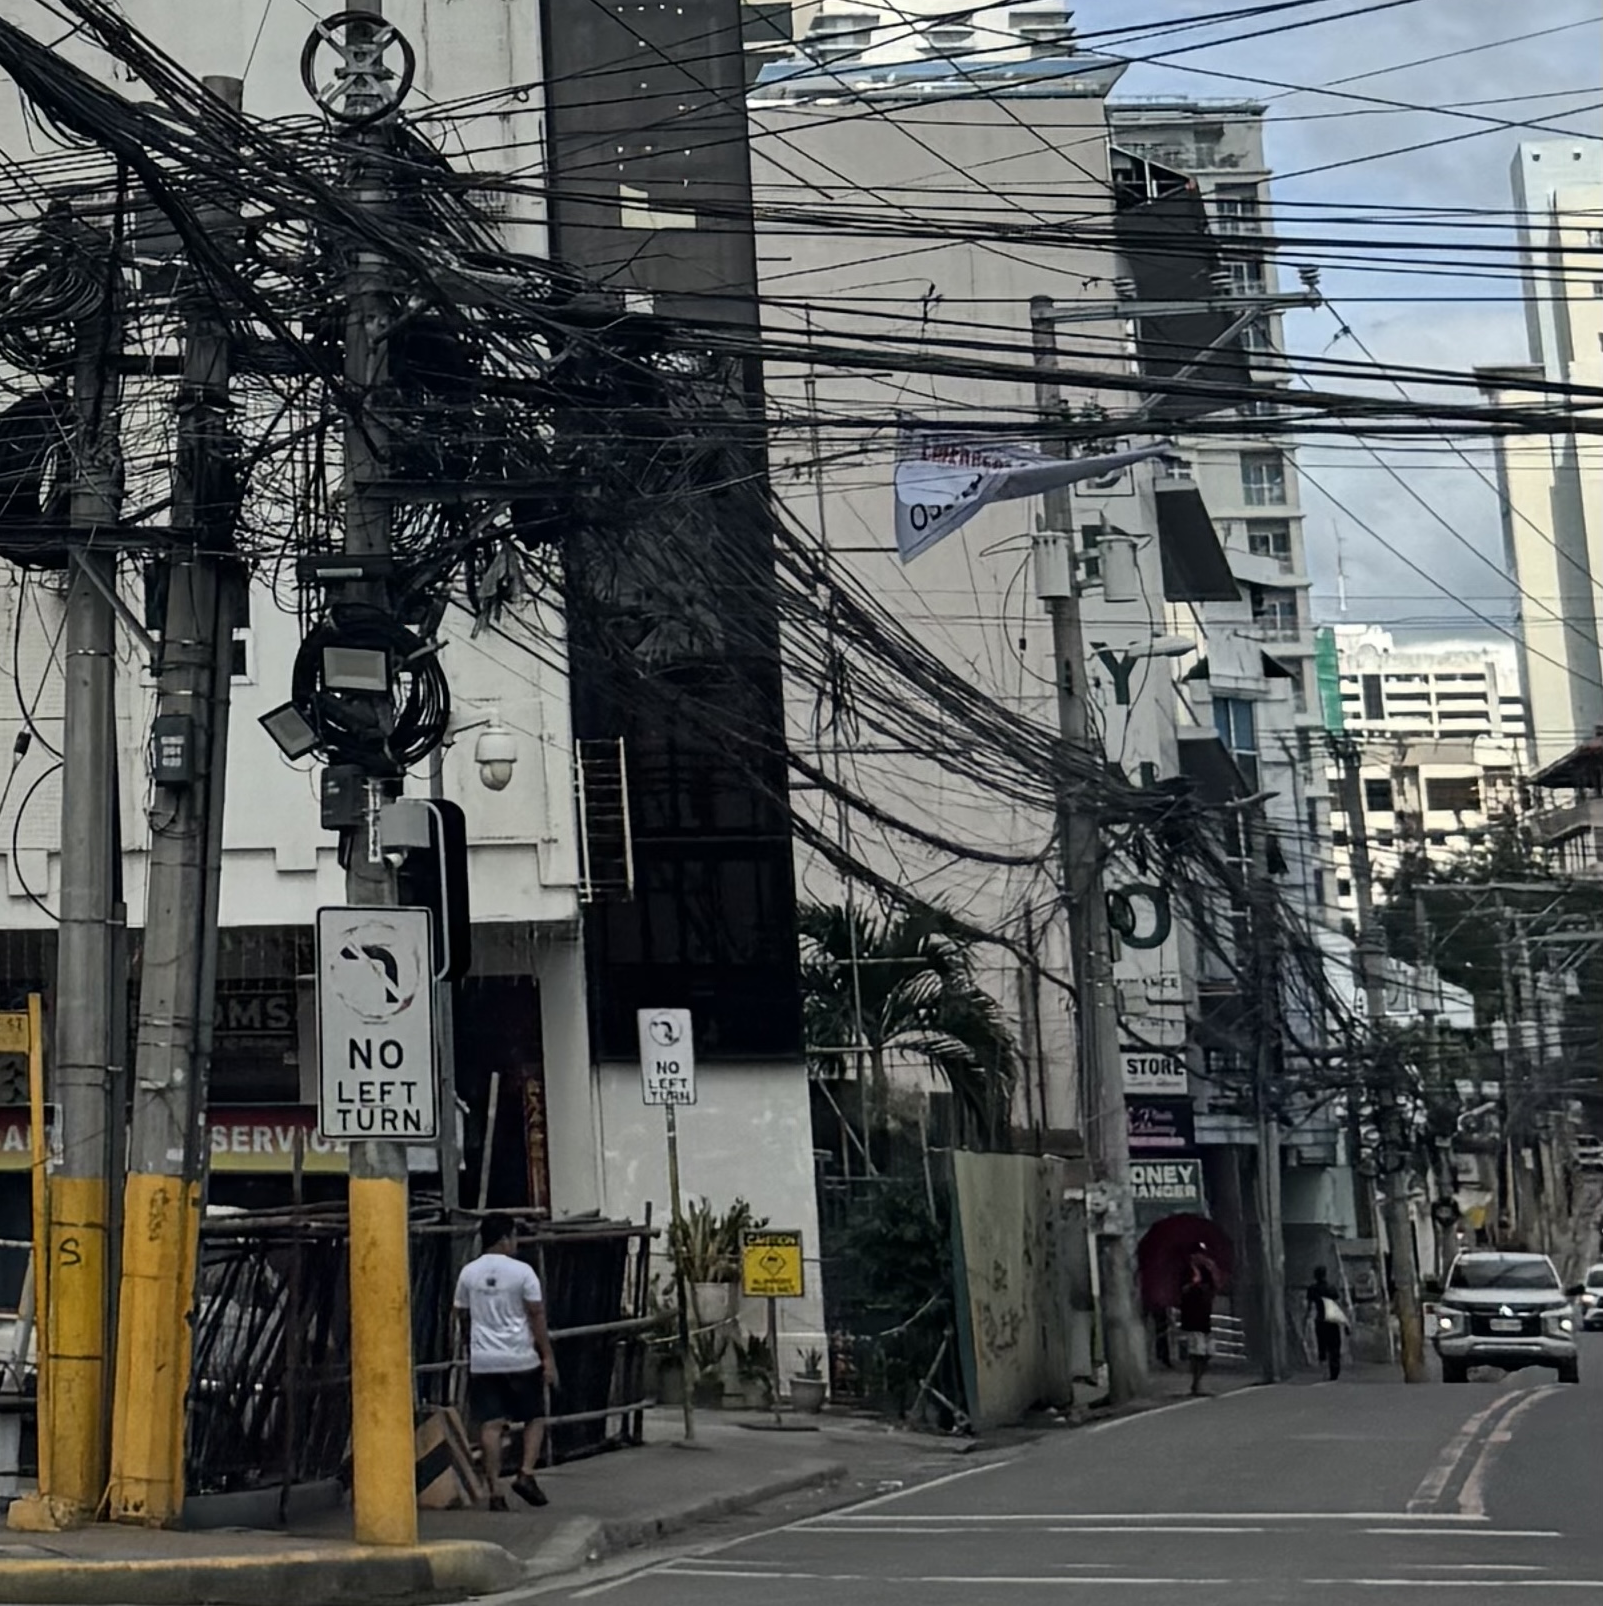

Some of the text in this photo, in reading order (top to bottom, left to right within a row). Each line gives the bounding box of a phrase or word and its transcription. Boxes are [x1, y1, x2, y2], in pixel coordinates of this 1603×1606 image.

[349, 1038, 404, 1070] NO
[656, 1060, 680, 1075] NO
[1127, 1058, 1185, 1076] STORE
[648, 1078, 688, 1089] LEFT
[337, 1081, 418, 1105] LEFT
[650, 1091, 691, 1103] TURN
[336, 1108, 421, 1132] TURN
[1130, 1165, 1193, 1184] ONEY
